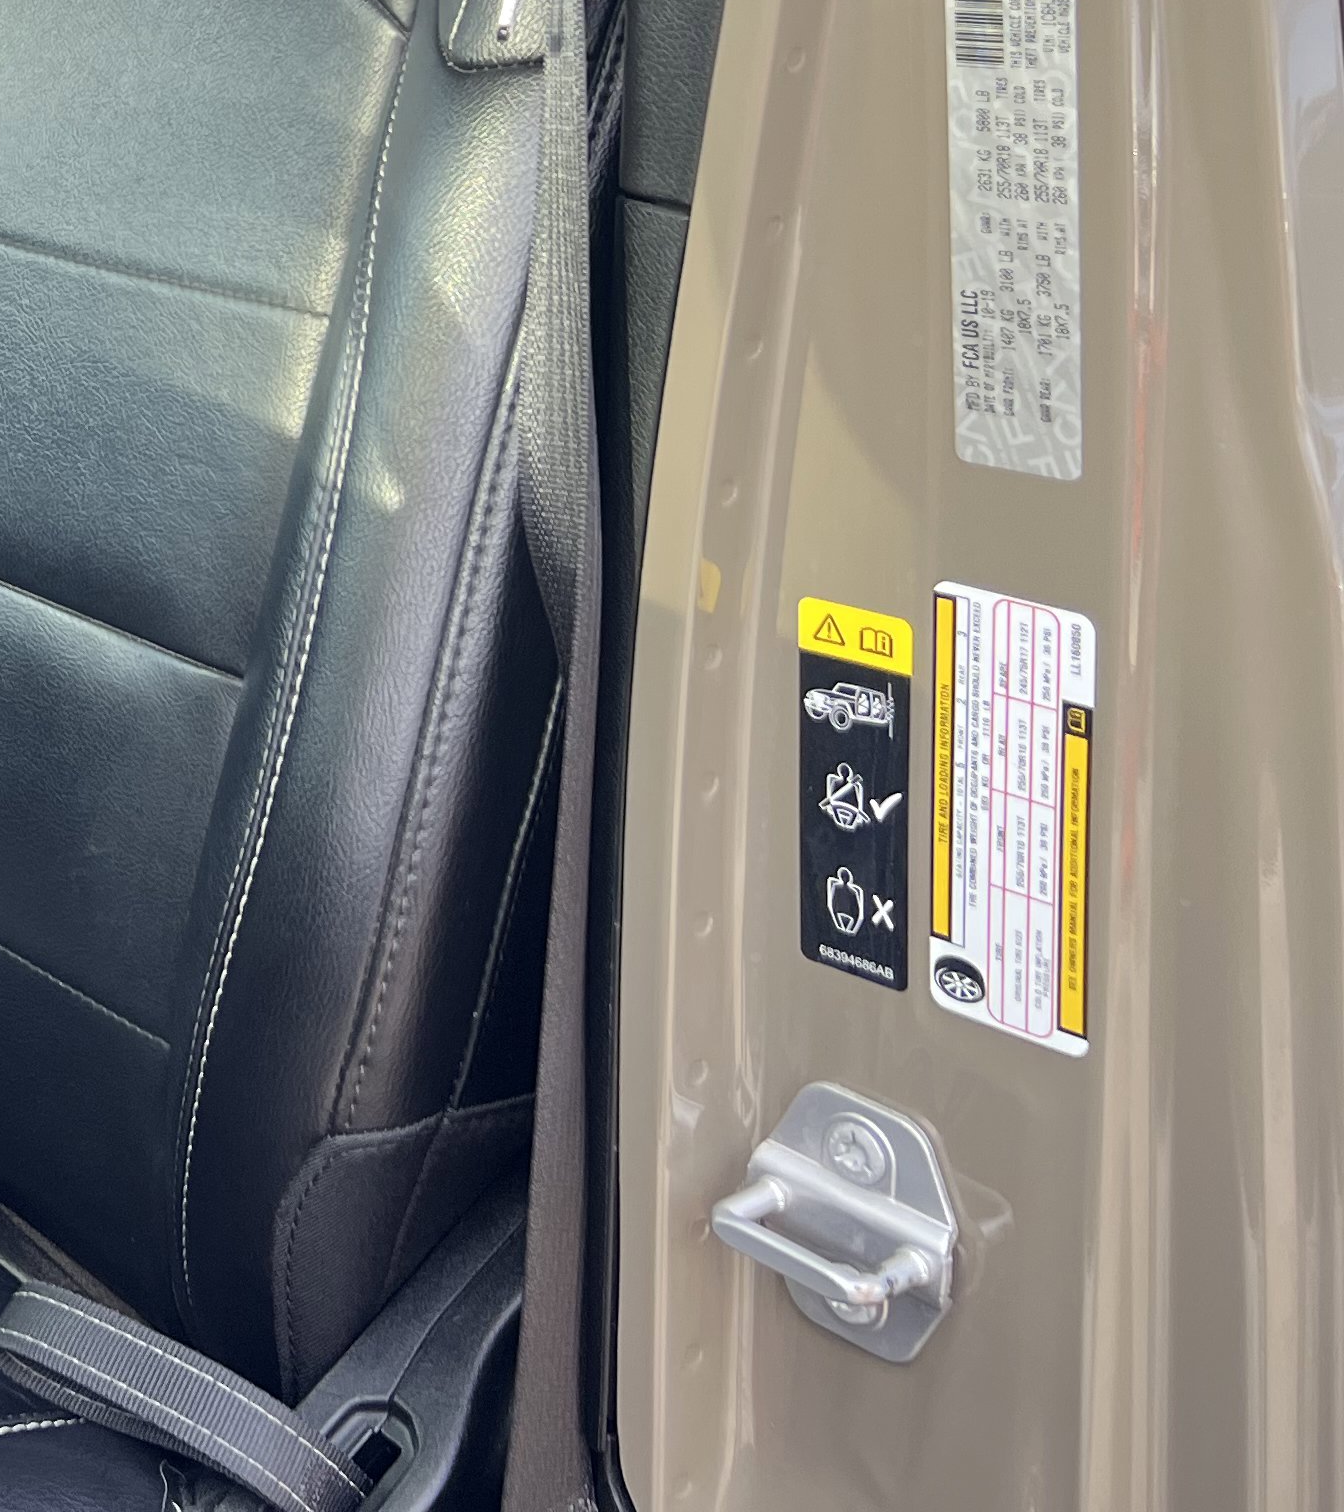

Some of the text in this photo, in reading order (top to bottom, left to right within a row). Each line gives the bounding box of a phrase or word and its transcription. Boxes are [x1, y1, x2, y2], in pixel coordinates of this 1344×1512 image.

[1009, 15, 1022, 47] VEHICLE
[1057, 21, 1071, 54] VEHICLE
[975, 90, 990, 102] LB
[976, 108, 991, 132] 5800
[995, 115, 1011, 139] 113T
[1033, 118, 1048, 143] 113T
[1012, 133, 1028, 145] 38
[1051, 135, 1066, 148] 38
[976, 149, 991, 162] KG
[977, 168, 993, 192] 2631
[996, 145, 1012, 199] 255/70R18
[1033, 148, 1049, 203] 255/70R18
[1014, 182, 1029, 202] 260
[1052, 185, 1068, 205] 260
[998, 250, 1014, 263] LB
[1035, 254, 1051, 267] LB
[999, 268, 1014, 292] 3100
[1036, 272, 1051, 297] 3750
[960, 289, 978, 314] LLC
[1000, 309, 1015, 322] KG
[1017, 298, 1032, 335] 18X7.5
[1037, 314, 1052, 327] KG
[1054, 303, 1070, 339] 18X7.5
[961, 319, 979, 338] US
[1000, 326, 1016, 351] 1407
[1037, 333, 1053, 356] 1701
[962, 344, 979, 370] FCA
[965, 374, 980, 387] BY
[983, 381, 995, 391] OF
[973, 601, 982, 633] EXCEED
[972, 635, 981, 663] NEVER
[971, 665, 981, 698] SHOULD
[971, 699, 981, 728] CARGO
[970, 730, 980, 746] AND
[938, 683, 950, 843] TIRE AND LOADING INFORMATION
[969, 813, 979, 844] WEIGHT
[968, 848, 979, 890] COMBINED
